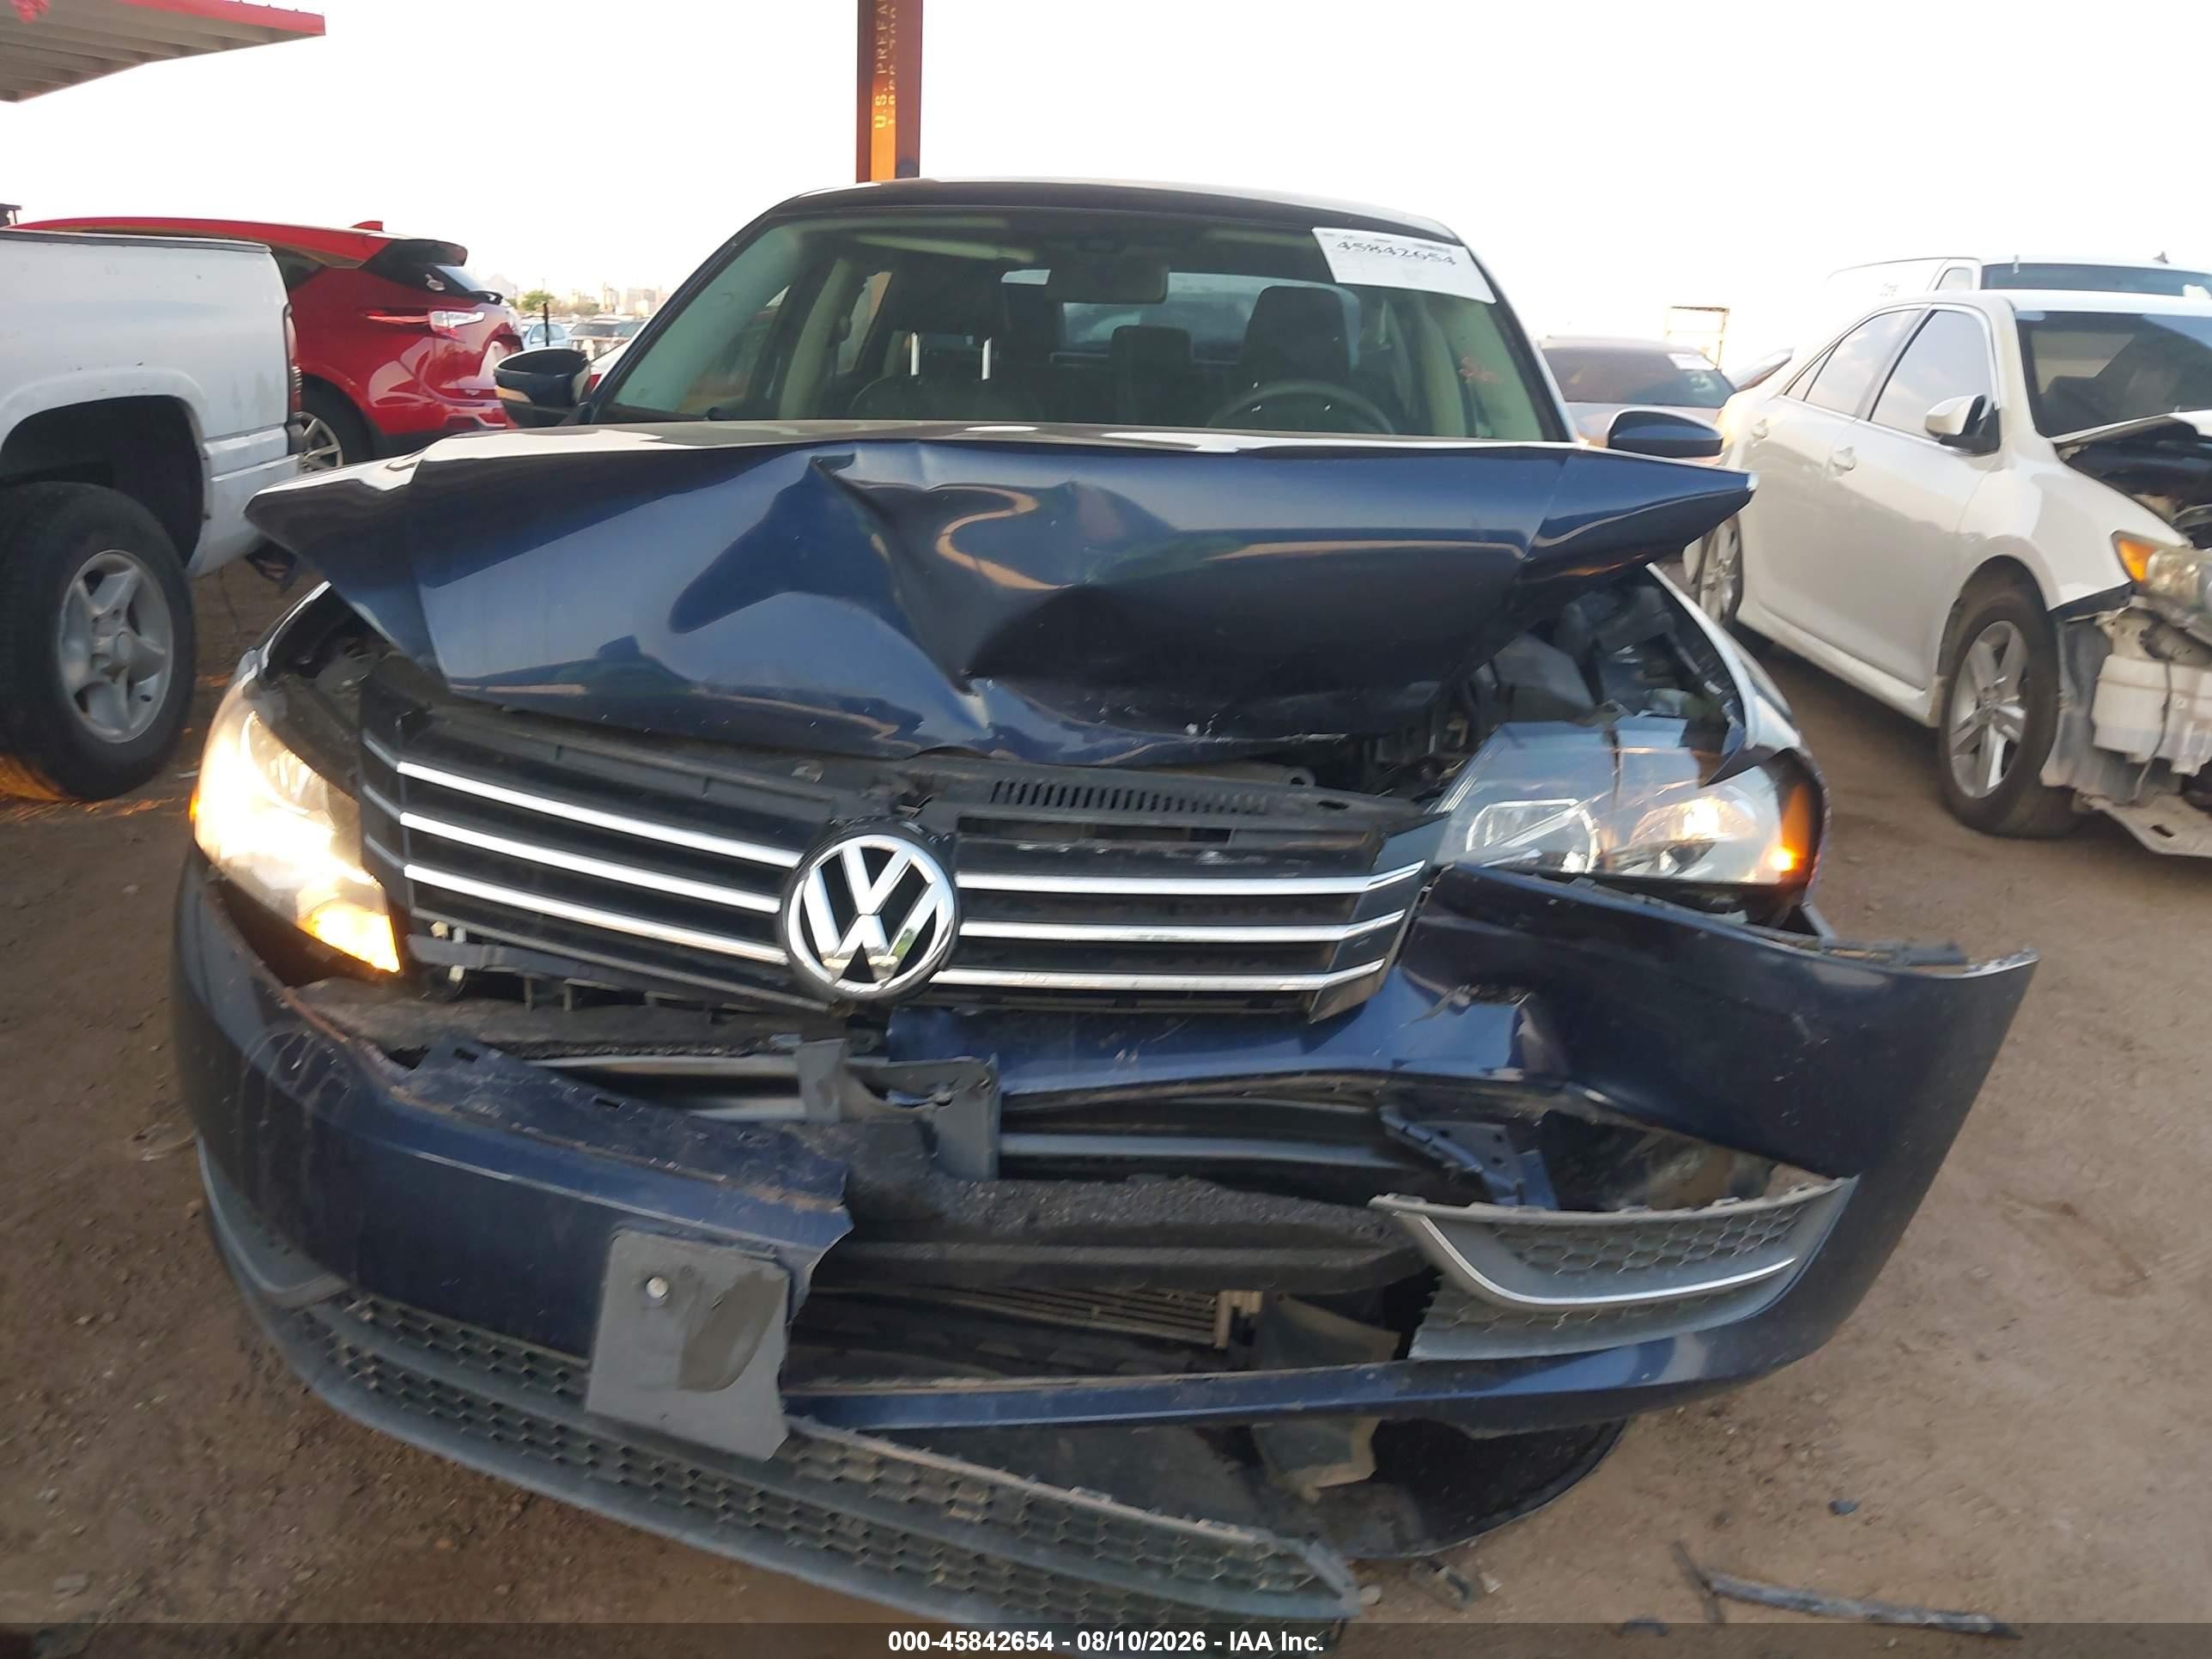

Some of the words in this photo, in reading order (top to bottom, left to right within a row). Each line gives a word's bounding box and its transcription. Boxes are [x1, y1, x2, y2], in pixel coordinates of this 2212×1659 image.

[876, 0, 889, 74] PREFA
[874, 87, 889, 129] U.S.
[792, 836, 951, 990] VW
